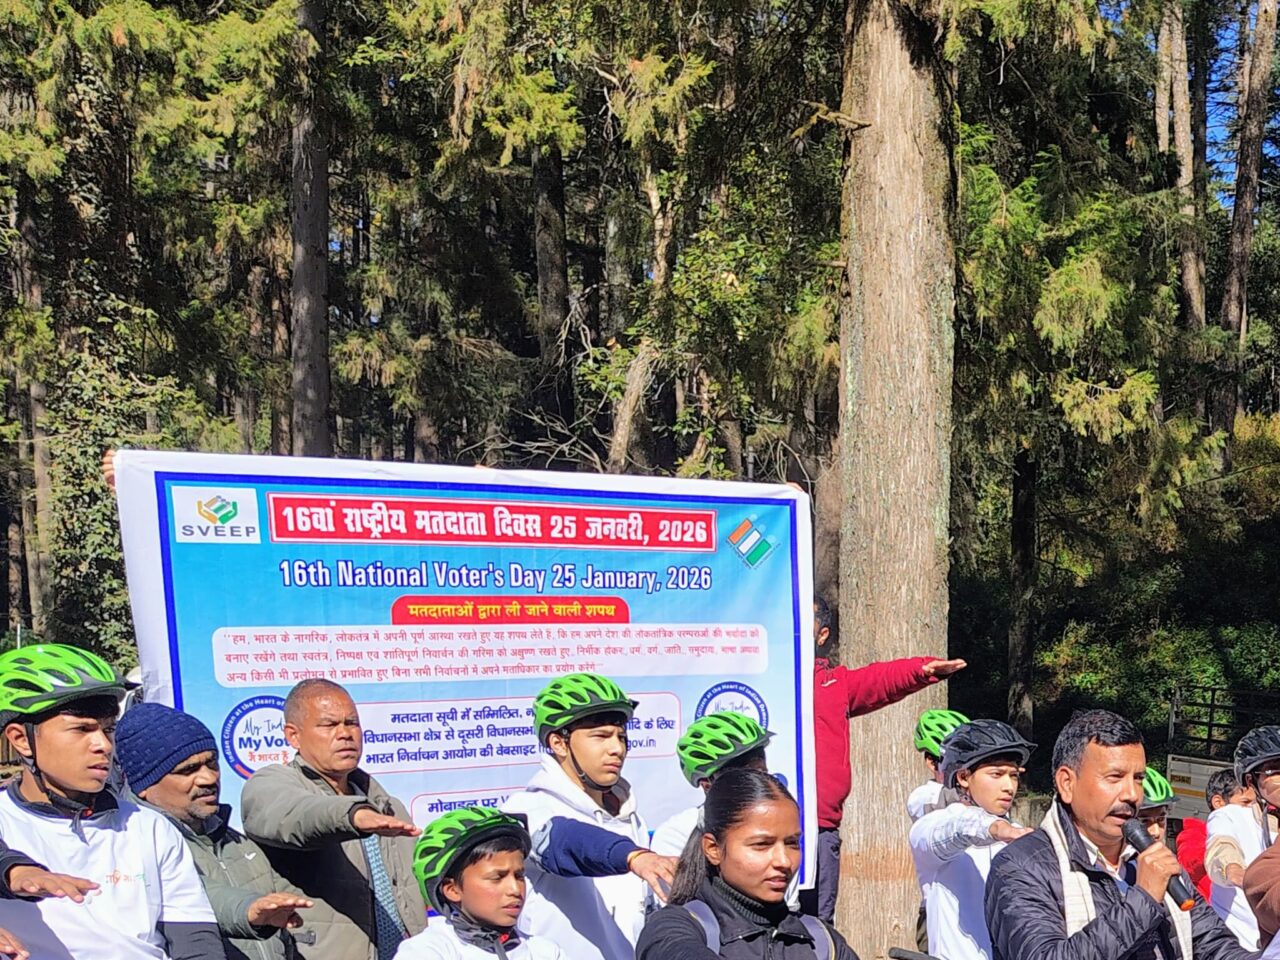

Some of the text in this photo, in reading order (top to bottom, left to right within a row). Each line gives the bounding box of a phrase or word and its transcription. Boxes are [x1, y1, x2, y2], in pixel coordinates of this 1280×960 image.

[181, 524, 257, 538] SVEEP
[281, 500, 707, 545] 16वां राष्ट्रीय मतदाता दिवस 25 जनवरी, 2026
[279, 558, 713, 594] 16th National Voter's Day 25 January, 2026
[408, 600, 616, 621] मतदाताओं द्वारा ली जाने वाली शपथ
[254, 633, 277, 644] भारत
[281, 630, 290, 643] के
[383, 629, 407, 641] अपनी
[410, 629, 425, 644] पूर्ण
[458, 629, 477, 640] रखते
[493, 631, 504, 641] यह
[507, 631, 527, 640] शपथ
[530, 628, 543, 640] लेते
[570, 630, 581, 639] हम
[584, 628, 602, 639] अपने
[225, 652, 249, 664] बनाए
[279, 652, 298, 662] तथा
[458, 646, 468, 658] की
[497, 646, 507, 657] को
[227, 671, 247, 682] अन्य
[251, 668, 274, 681] किसी
[279, 668, 289, 680] भी
[392, 666, 411, 678] बिना
[481, 663, 500, 675] अपने
[391, 712, 433, 724] मतदाता
[436, 707, 458, 726] सूची
[460, 707, 472, 721] में
[238, 735, 290, 752] My Vot
[363, 729, 420, 744] विधानसभा
[423, 727, 441, 741] क्षेत्र
[445, 726, 455, 740] से
[458, 724, 484, 744] दूसरी
[366, 752, 394, 764] भारत
[397, 747, 439, 763] निर्वाचन
[442, 746, 477, 760] आयोग
[479, 745, 494, 757] की
[496, 743, 537, 756] वेबसाइट
